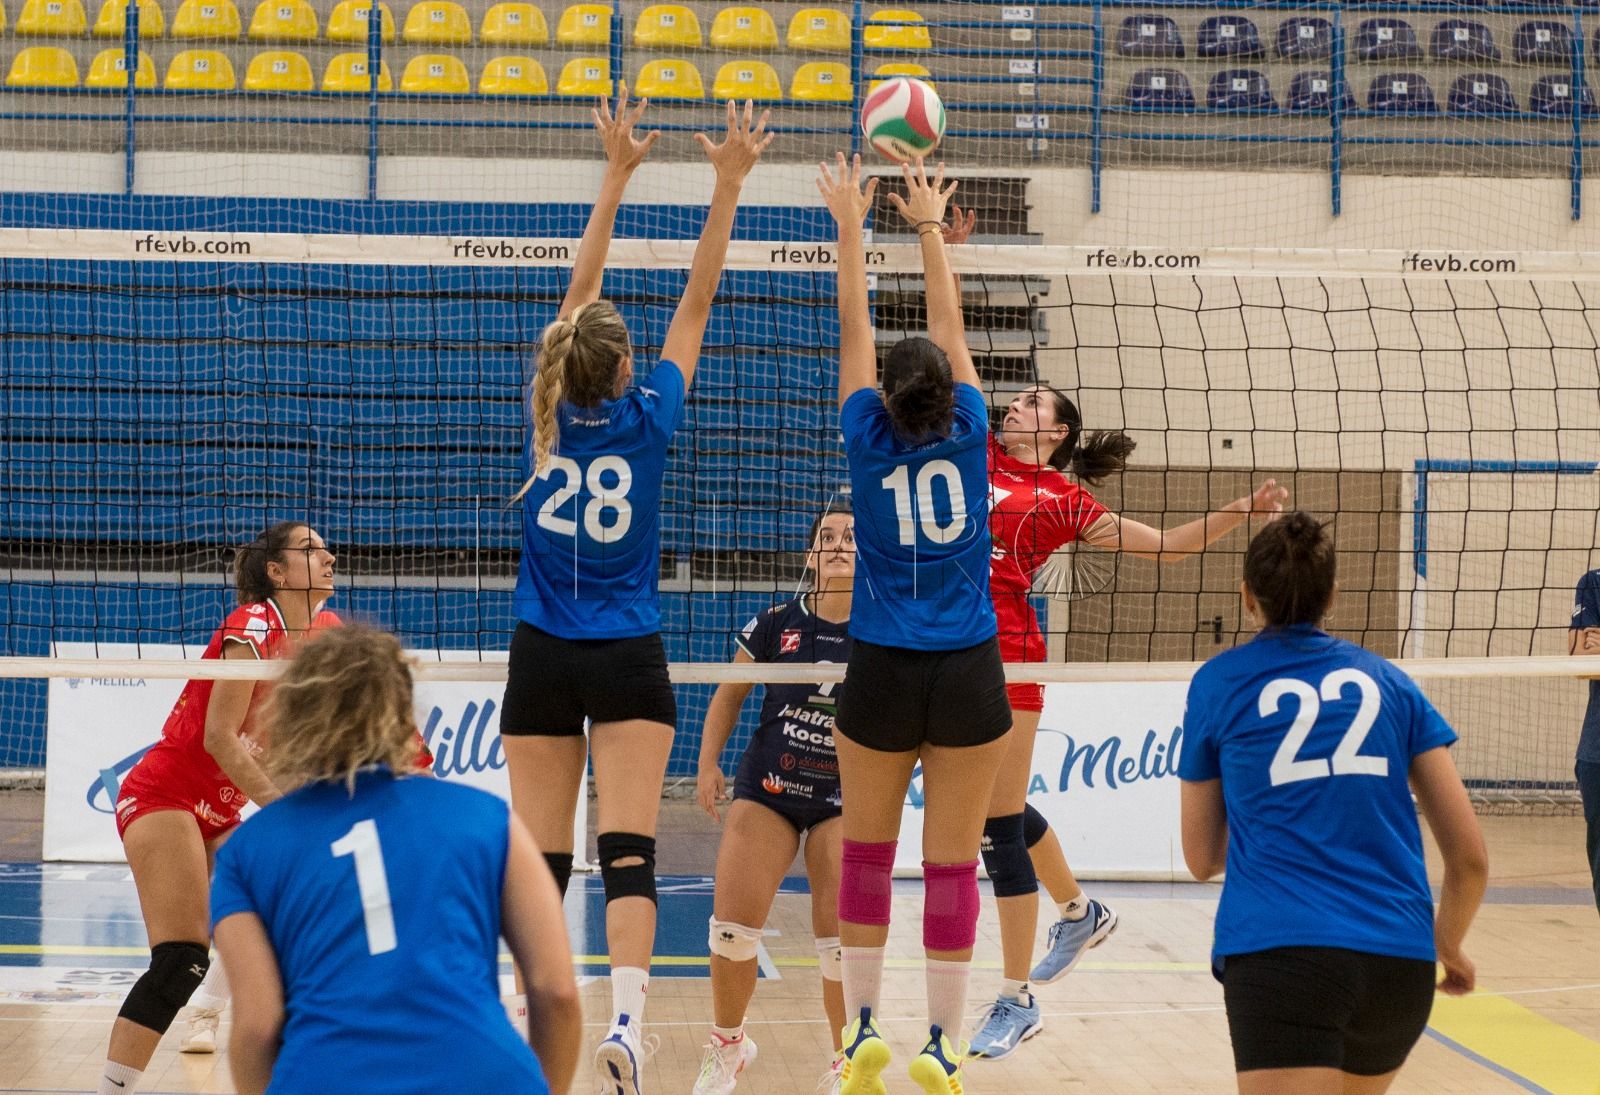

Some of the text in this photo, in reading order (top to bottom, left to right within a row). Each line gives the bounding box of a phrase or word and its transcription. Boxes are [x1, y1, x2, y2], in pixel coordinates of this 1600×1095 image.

[1024, 9, 1031, 18] 3
[135, 236, 251, 254] rfevb.com
[454, 241, 569, 259] rfevb.com
[770, 246, 885, 264] rfevb.m
[1402, 254, 1516, 272] rfevb.com
[537, 455, 632, 543] 28
[881, 459, 967, 545] 10
[1258, 668, 1388, 786] 22
[330, 818, 397, 956] 1
